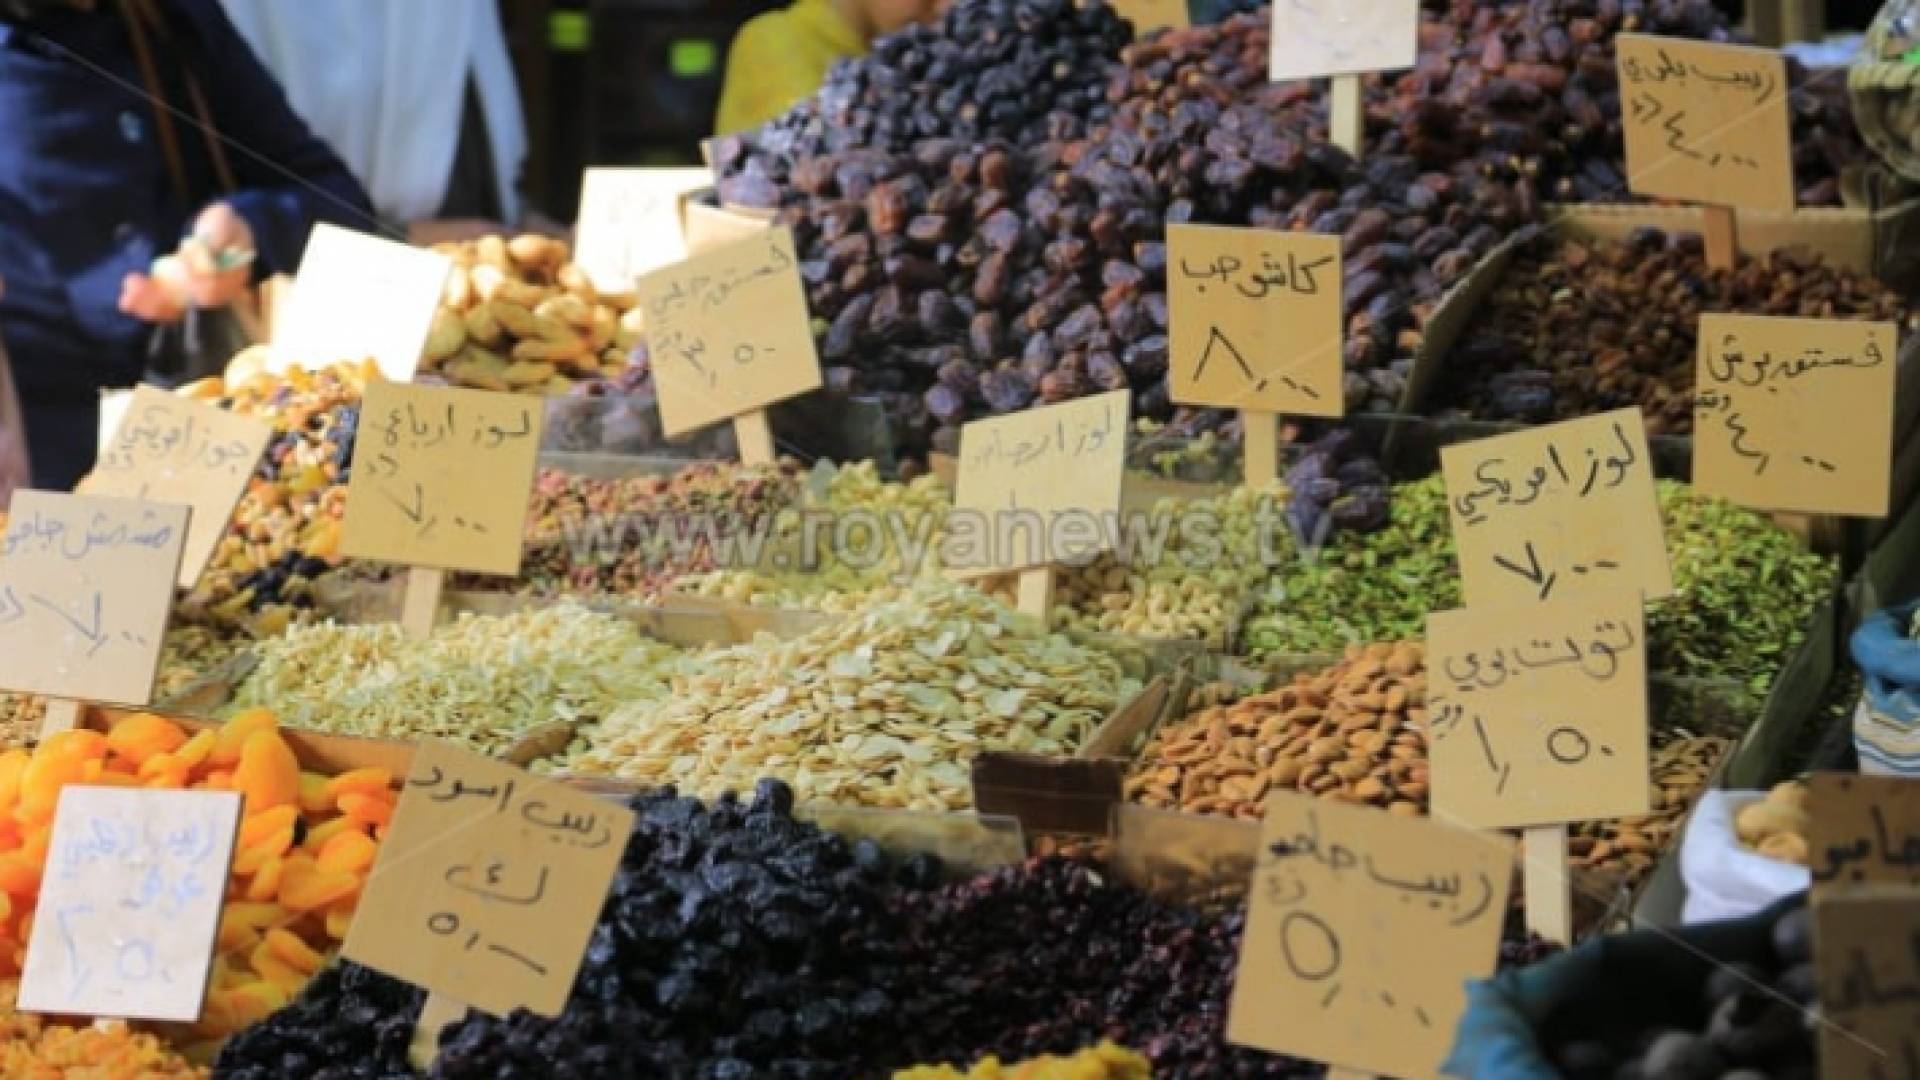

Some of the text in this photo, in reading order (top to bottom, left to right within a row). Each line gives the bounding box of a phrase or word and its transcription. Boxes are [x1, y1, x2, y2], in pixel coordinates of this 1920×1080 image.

[1179, 251, 1336, 298] كاشو حب
[471, 408, 530, 450] لوز
[1579, 421, 1638, 499] لوز
